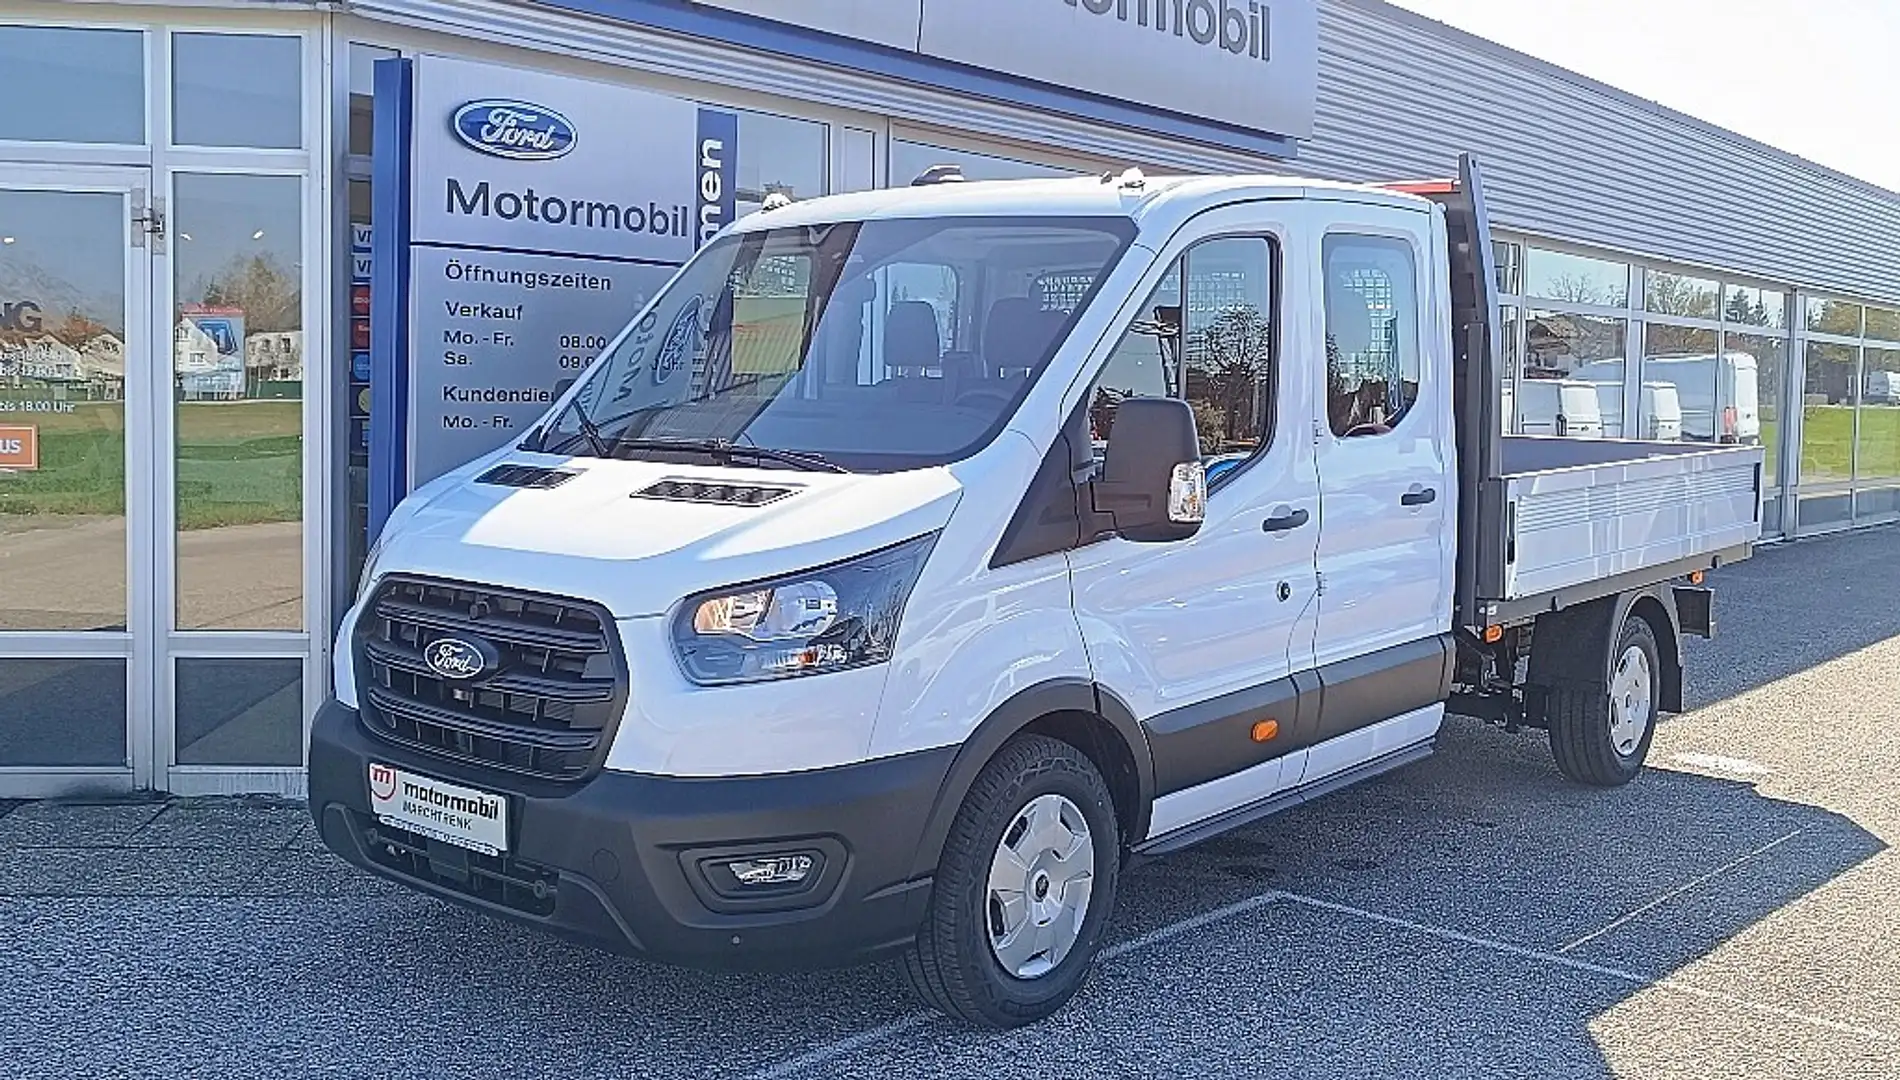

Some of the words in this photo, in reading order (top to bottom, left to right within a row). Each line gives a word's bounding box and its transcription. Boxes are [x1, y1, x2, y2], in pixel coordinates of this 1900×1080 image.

[480, 107, 556, 150] Ford
[446, 178, 688, 237] Motormobil
[445, 259, 611, 290] Öffnungszeiten
[445, 301, 523, 320] Verkauf
[443, 330, 478, 345] Mo.
[493, 332, 514, 347] Fr.
[443, 351, 473, 366] Sa.
[54, 400, 75, 413] Uhr
[442, 415, 478, 429] Mo.
[493, 416, 514, 428] Fr.
[434, 643, 480, 673] Ford
[402, 781, 499, 820] motormobil
